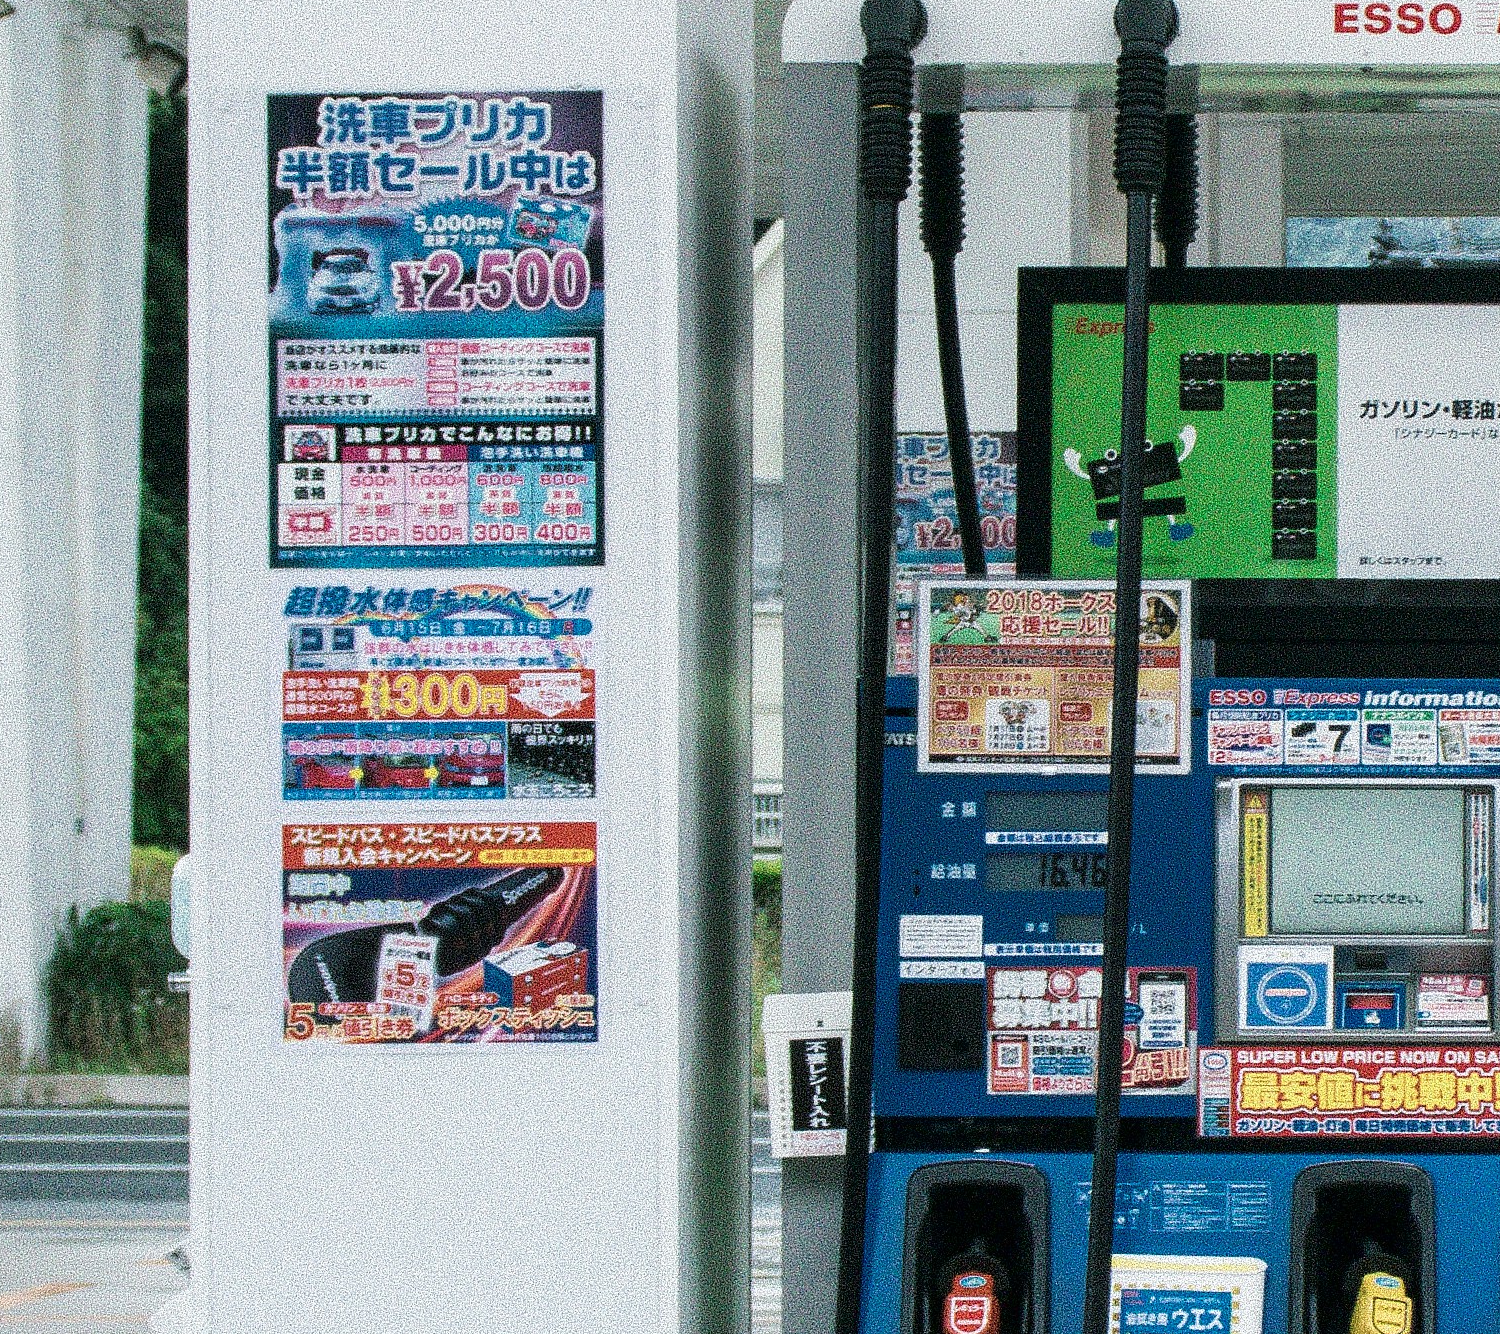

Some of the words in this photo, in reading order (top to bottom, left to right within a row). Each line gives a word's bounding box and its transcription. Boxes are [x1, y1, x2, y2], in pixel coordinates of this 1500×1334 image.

[1334, 3, 1462, 35] ESSO
[321, 99, 549, 144] 洗車プリカ
[280, 148, 593, 194] 半額セール中は
[392, 249, 590, 312] ¥2,500
[897, 435, 1002, 459] 車プカ
[348, 525, 399, 542] 250円
[411, 525, 463, 542] 500円
[474, 525, 528, 542] 300円
[536, 525, 591, 542] 400円
[916, 517, 1017, 550] ¥2,00
[986, 591, 1116, 613] 2018ホークス
[1000, 616, 1110, 636] 応援セール!!
[392, 672, 509, 718] 300円
[1209, 689, 1267, 706] ESSO
[1284, 689, 1360, 709] Express
[438, 1008, 595, 1029] ボックスティッシュ
[1237, 1051, 1296, 1064] SUPER
[1301, 1051, 1340, 1064] LOW
[1343, 1051, 1396, 1064] PRICE
[1400, 1051, 1440, 1064] NOW
[1444, 1051, 1471, 1064] ON
[1171, 1308, 1224, 1331] ウエス
